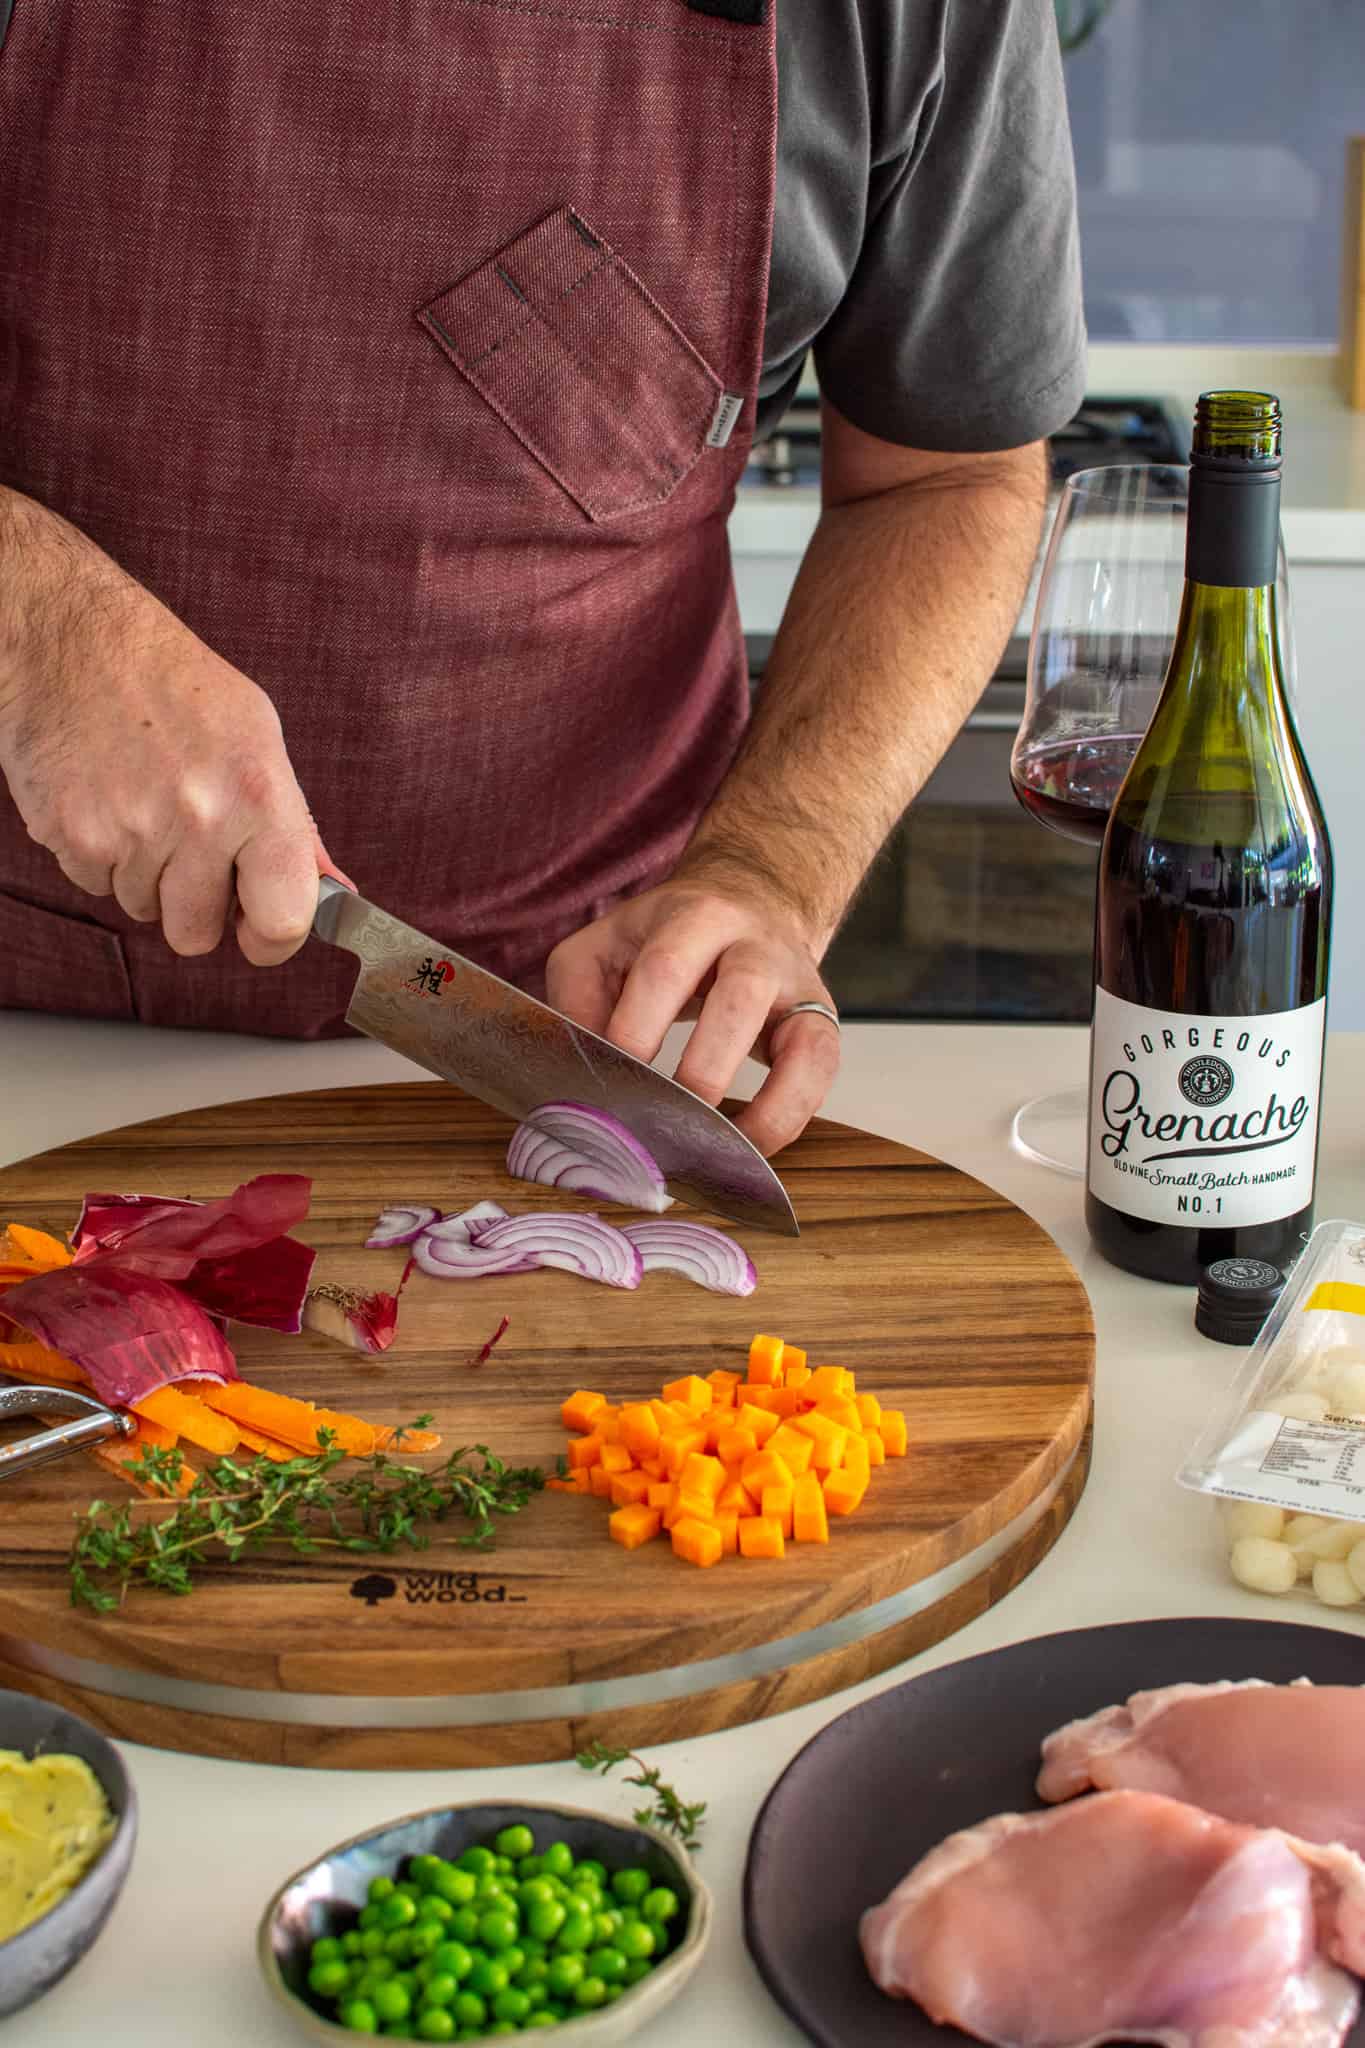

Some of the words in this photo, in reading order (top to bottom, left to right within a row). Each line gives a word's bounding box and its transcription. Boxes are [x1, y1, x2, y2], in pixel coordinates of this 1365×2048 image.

[1123, 1028, 1291, 1067] GORGEOUS
[1101, 1070, 1310, 1157] Grenache
[1113, 1158, 1128, 1172] OLD
[1129, 1163, 1149, 1179] VINE
[1149, 1168, 1199, 1186] Small
[1198, 1171, 1249, 1191] Batch
[1251, 1165, 1297, 1185] HANDMADE
[406, 1573, 478, 1590] wild
